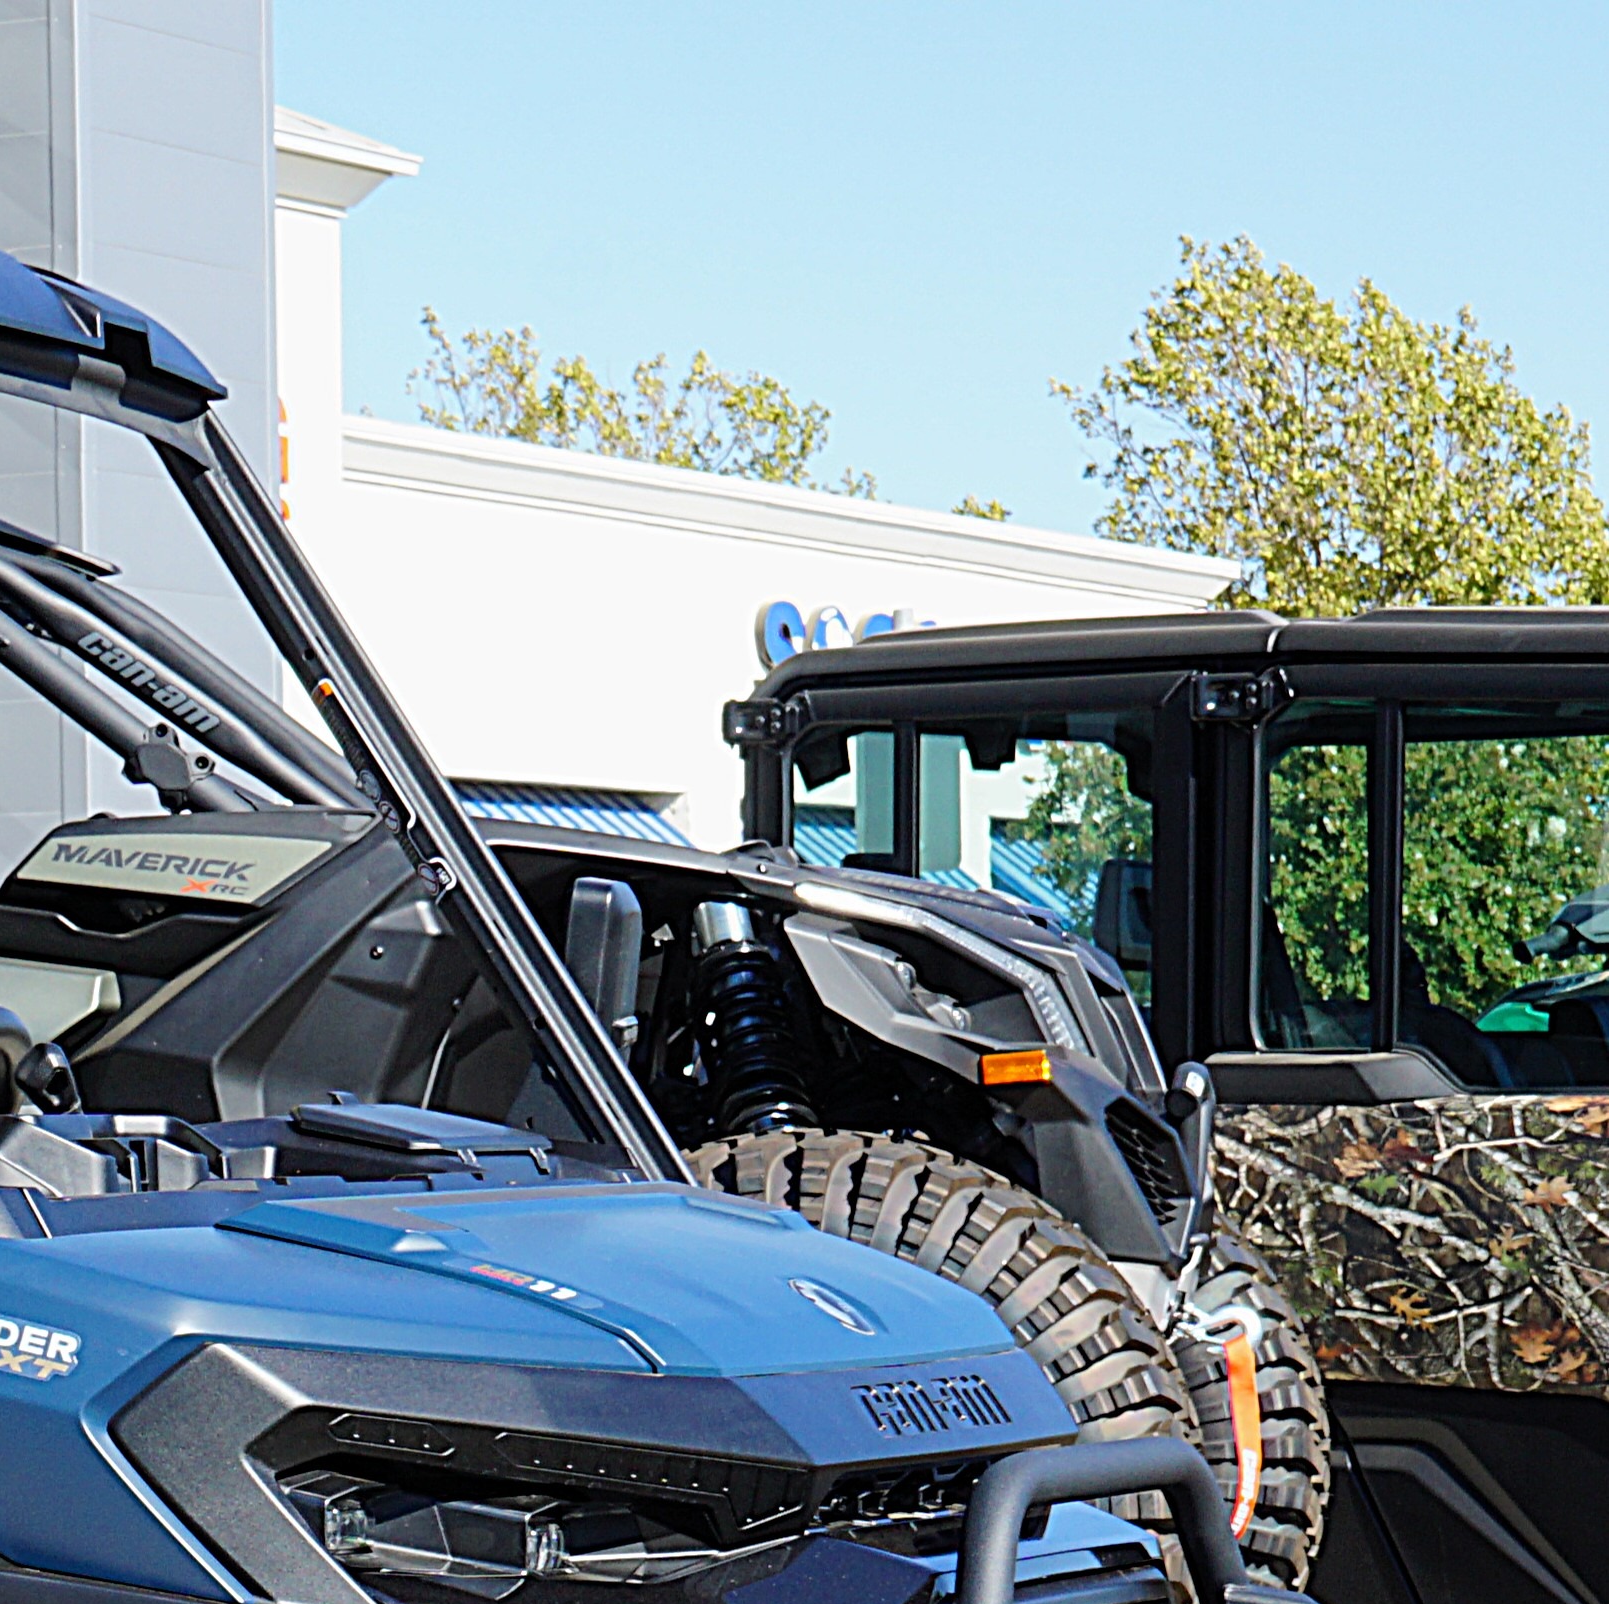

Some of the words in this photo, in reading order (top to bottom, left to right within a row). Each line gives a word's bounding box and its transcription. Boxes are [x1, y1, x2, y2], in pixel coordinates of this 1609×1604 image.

[78, 631, 221, 734] can-am
[52, 844, 258, 882] MAVERICK
[850, 1374, 1014, 1438] can-am
